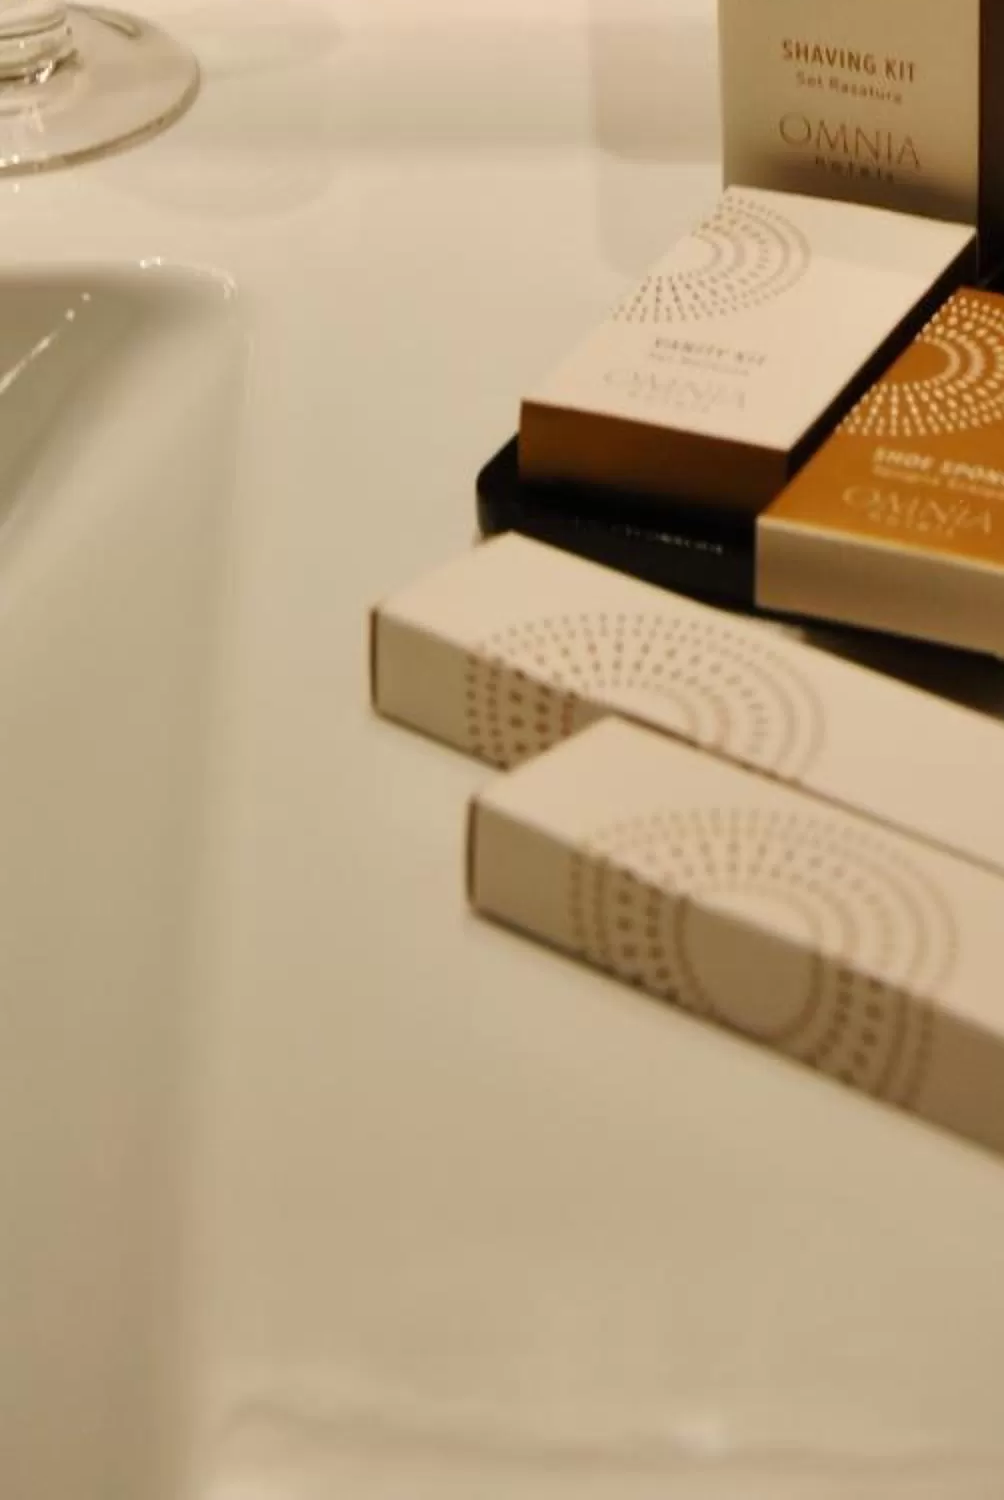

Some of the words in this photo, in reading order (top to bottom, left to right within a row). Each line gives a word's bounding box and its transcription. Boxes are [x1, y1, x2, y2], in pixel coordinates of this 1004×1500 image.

[782, 38, 877, 75] SHAVING
[884, 59, 917, 83] KIT
[796, 71, 822, 89] Set
[779, 111, 921, 169] OMNIA
[872, 447, 935, 472] SHOE
[842, 484, 993, 537] OMNIA
